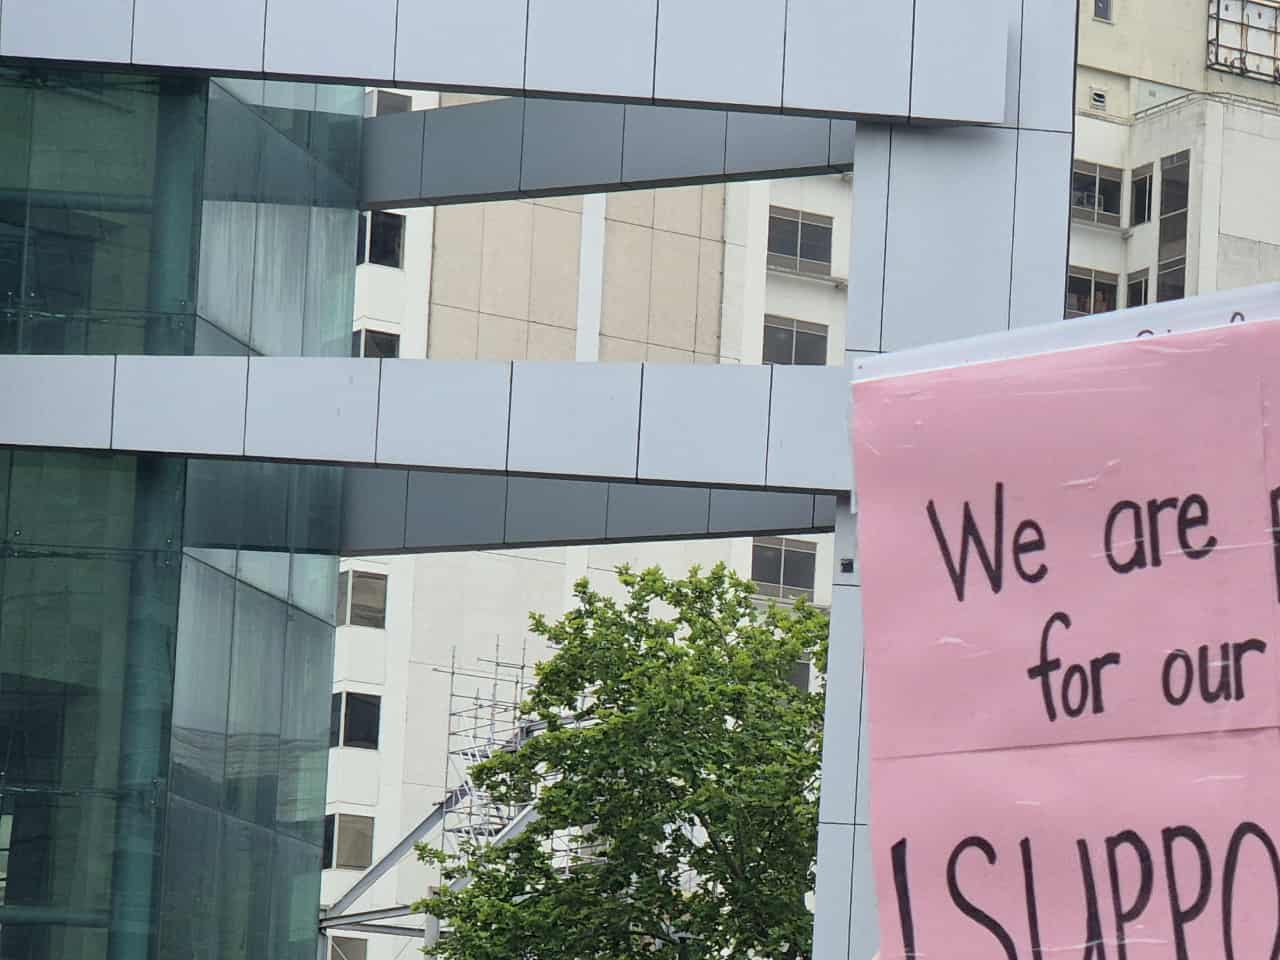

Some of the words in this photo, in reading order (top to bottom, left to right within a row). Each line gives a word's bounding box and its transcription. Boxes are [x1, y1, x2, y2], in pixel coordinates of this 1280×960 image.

[927, 482, 1048, 602] We
[1104, 494, 1218, 574] are
[1027, 612, 1121, 722] for
[1161, 638, 1266, 706] our
